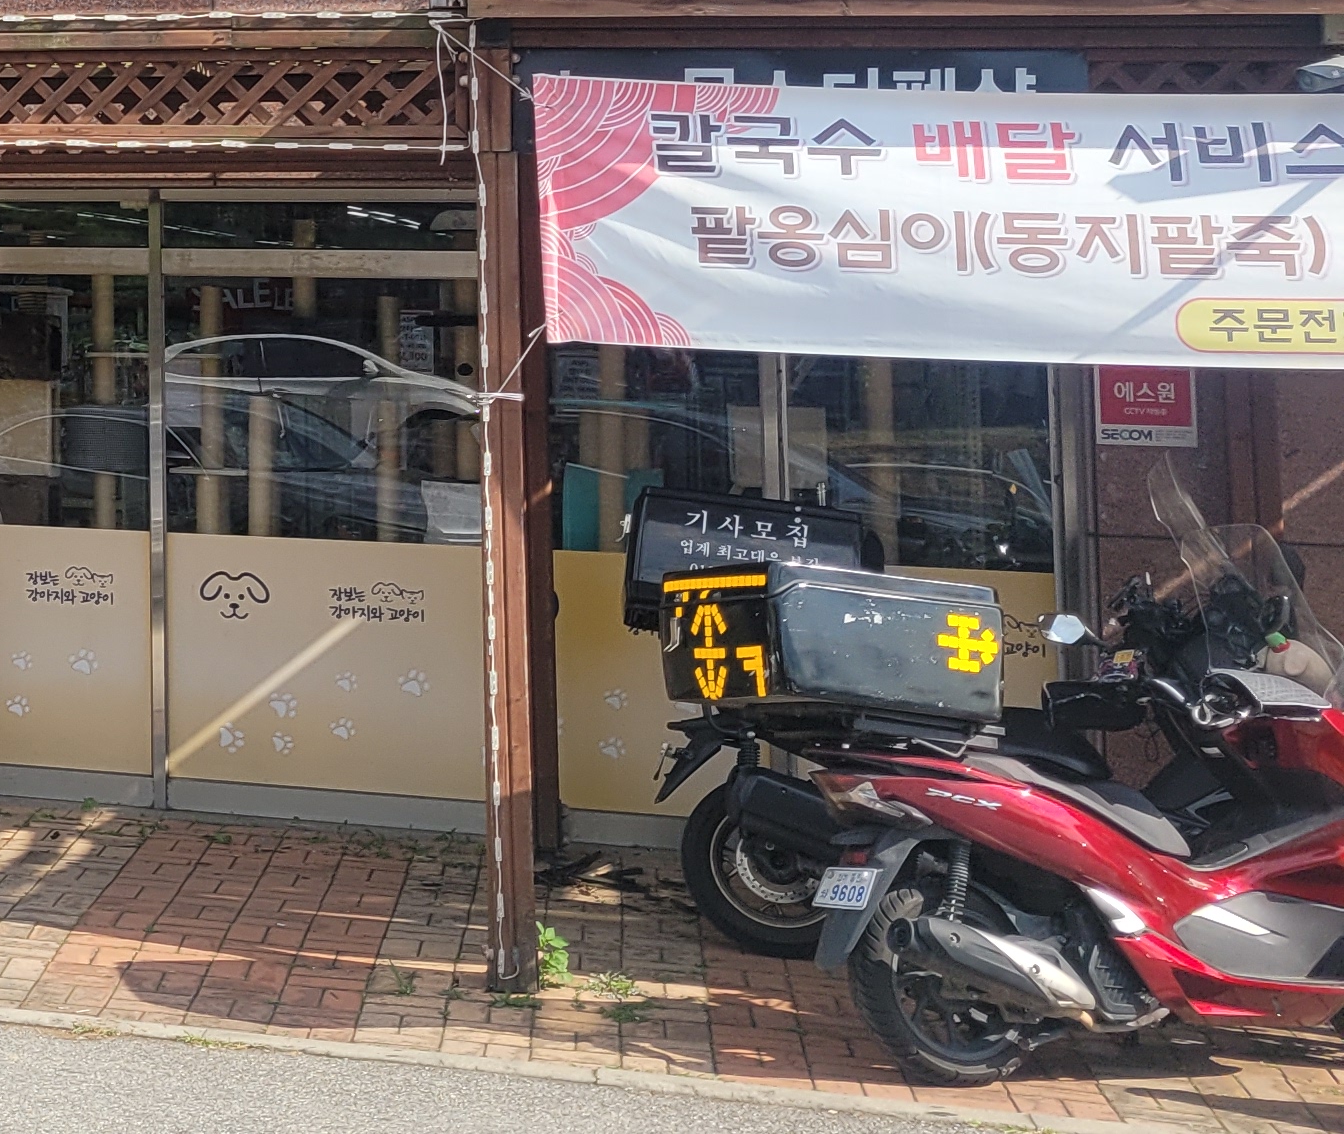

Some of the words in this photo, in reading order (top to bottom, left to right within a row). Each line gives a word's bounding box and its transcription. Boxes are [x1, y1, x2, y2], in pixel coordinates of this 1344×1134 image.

[649, 112, 889, 179] 칼국수
[912, 120, 1080, 184] 배달
[1108, 122, 1344, 183] 서비스
[690, 203, 1328, 278] 팥옹심이(동지팥죽)
[1113, 381, 1176, 403] 에스원
[1124, 407, 1146, 415] CCTV
[1100, 428, 1153, 442] SECOM
[684, 509, 809, 548] 기사모집
[680, 539, 711, 557] 업계
[26, 570, 60, 586] 장보는
[26, 587, 77, 604] 강아지와
[79, 589, 113, 605] 고양이
[328, 586, 366, 603] 장보는
[328, 603, 385, 623] 강아지와
[386, 607, 425, 623] 고양이
[925, 787, 1002, 811] PCX
[829, 884, 866, 903] 9608
